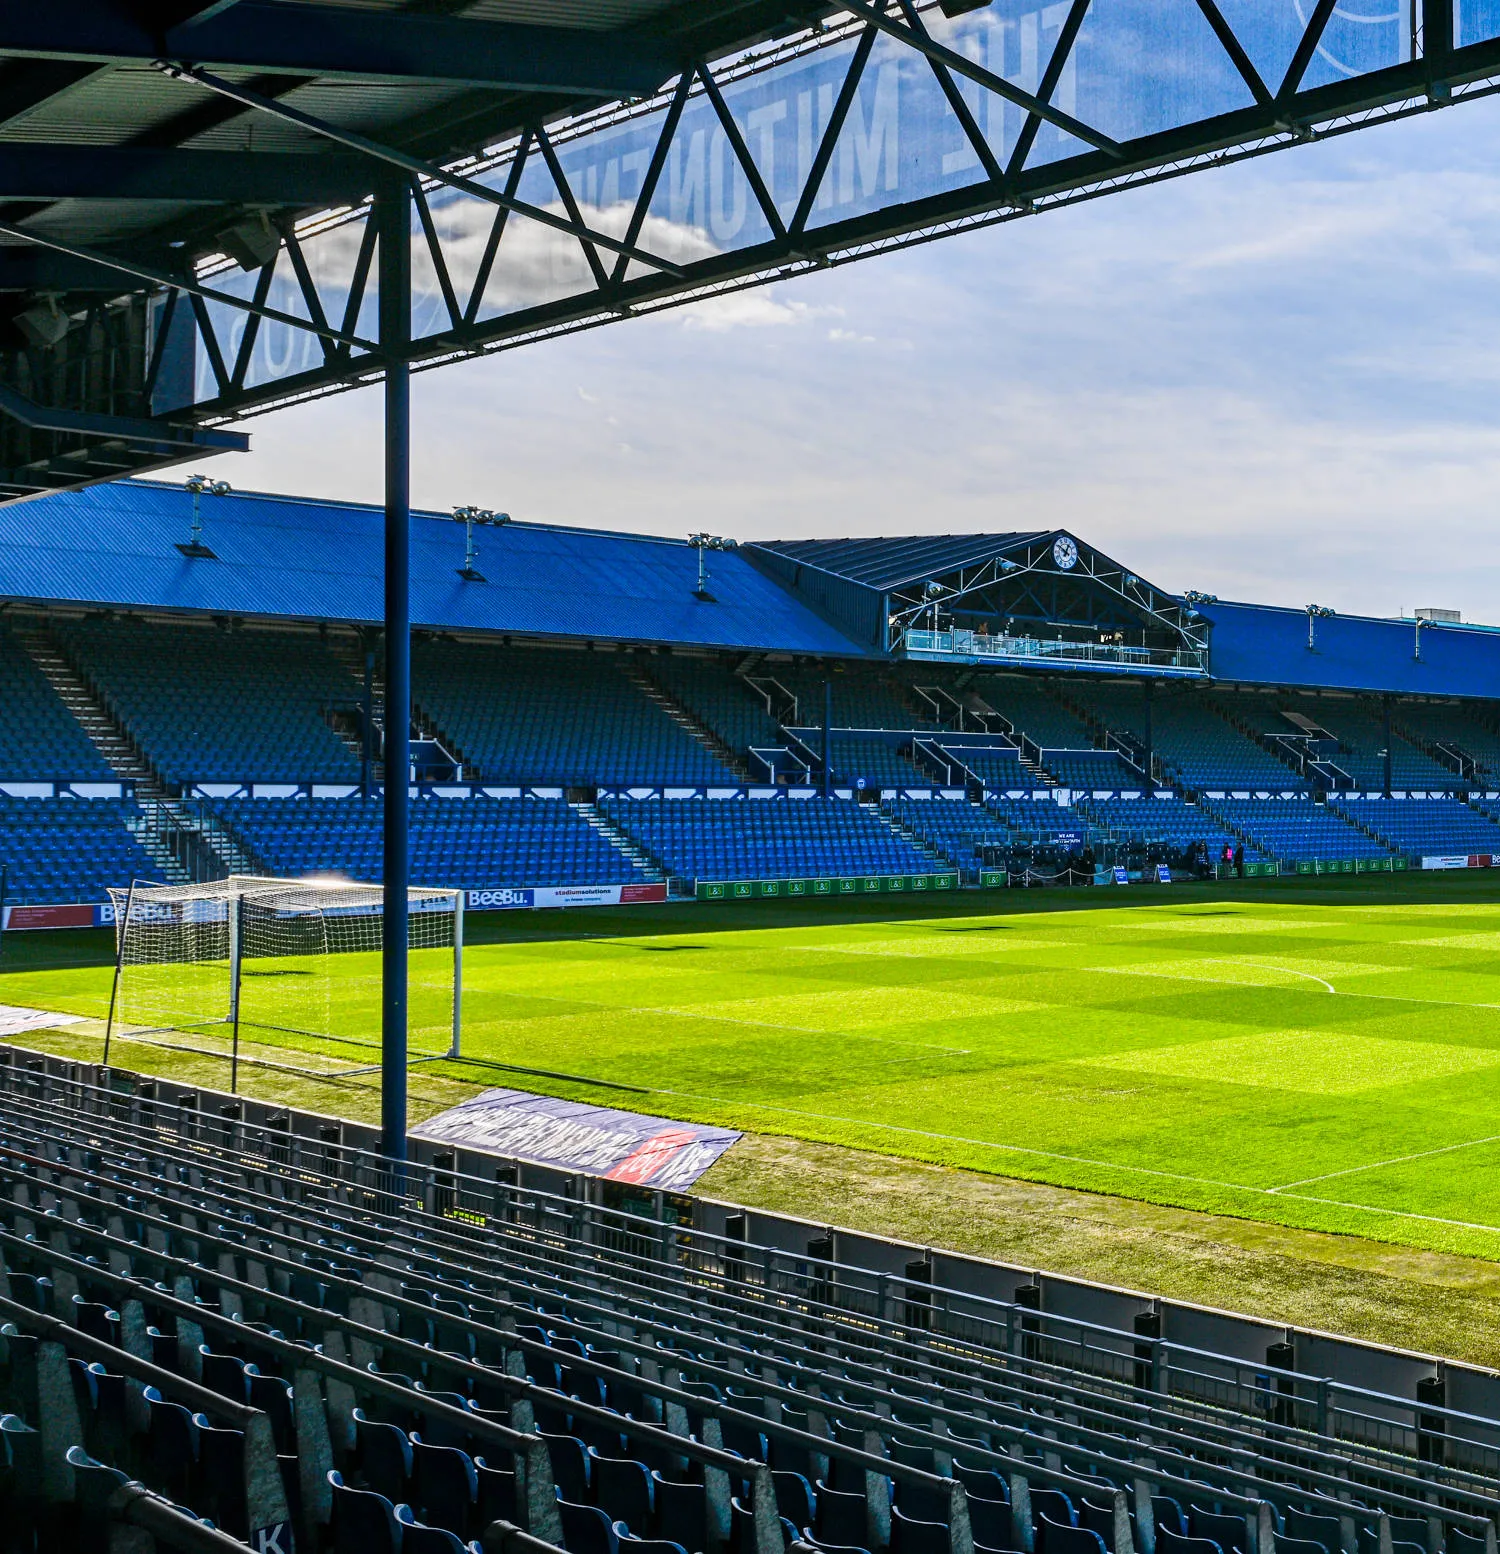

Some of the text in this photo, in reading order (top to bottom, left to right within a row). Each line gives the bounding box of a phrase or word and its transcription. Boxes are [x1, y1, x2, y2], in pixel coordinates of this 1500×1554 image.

[841, 881, 853, 889] L&S
[866, 881, 878, 889] L&S
[890, 880, 902, 888] L&S
[914, 879, 926, 887] L&S
[937, 878, 948, 886] L&S
[736, 886, 749, 894] L&S
[763, 885, 776, 893] L&S
[790, 884, 803, 892] L&S
[816, 882, 828, 891] L&S
[708, 887, 722, 896] L&S
[259, 1523, 286, 1554] K
